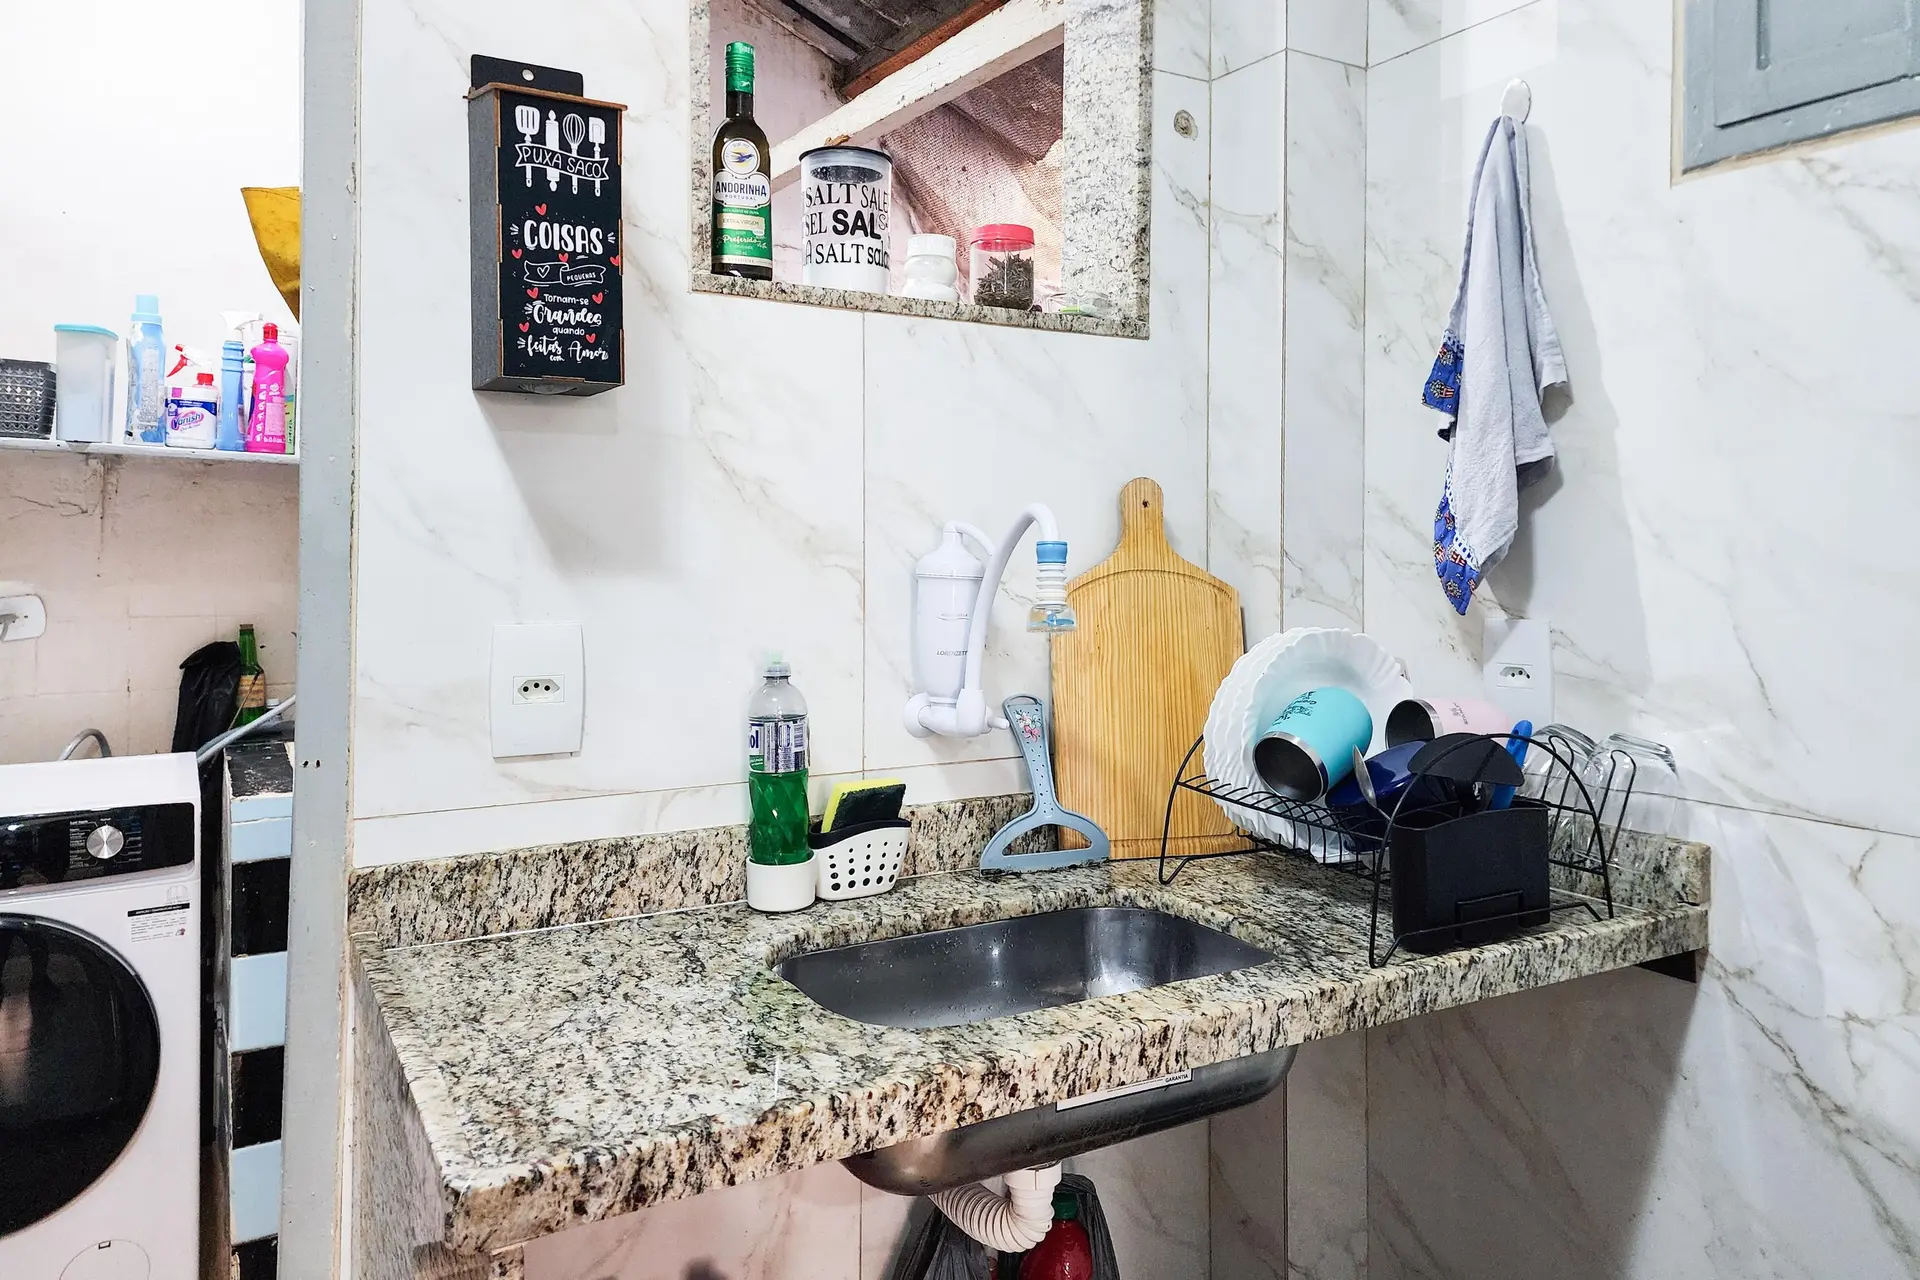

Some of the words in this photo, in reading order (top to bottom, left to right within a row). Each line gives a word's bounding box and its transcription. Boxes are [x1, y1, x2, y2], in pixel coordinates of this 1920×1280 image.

[522, 146, 562, 169] PUXA
[566, 157, 602, 178] SACO
[715, 181, 767, 197] ANDORINHA
[805, 183, 857, 208] SALT
[805, 211, 827, 237] SEL
[832, 209, 881, 240] SAL
[523, 219, 604, 255] COISAS
[815, 242, 865, 265] SALT
[566, 271, 597, 282] PEQUENAS
[543, 293, 589, 306] Tornam-se
[533, 303, 602, 326] Grandes
[552, 327, 585, 336] quando
[526, 334, 562, 357] feitas
[567, 340, 609, 361] Amor
[173, 412, 201, 429] Vanish
[1165, 1073, 1188, 1083] GARANTIA
